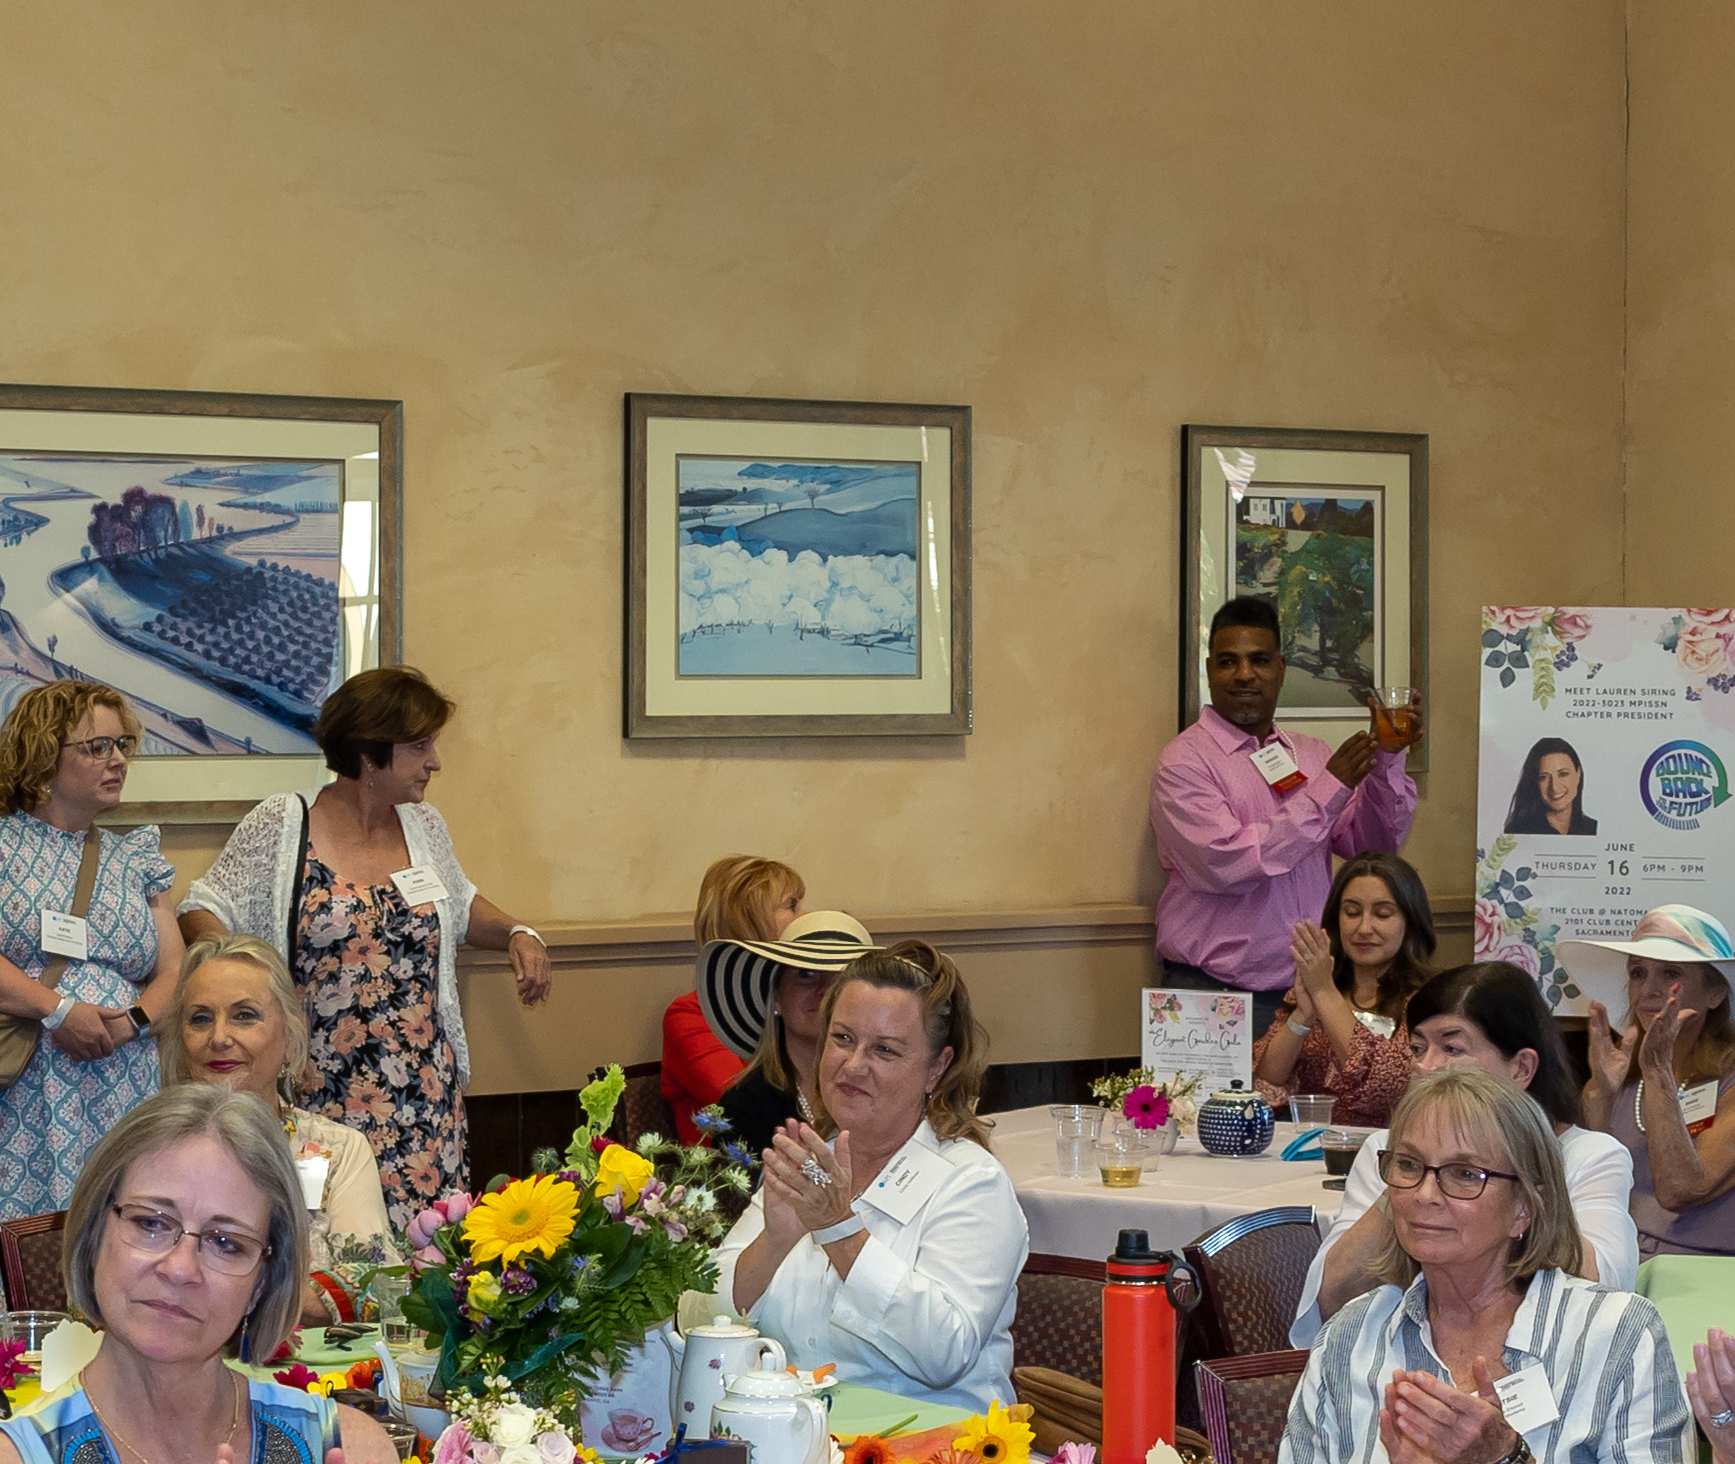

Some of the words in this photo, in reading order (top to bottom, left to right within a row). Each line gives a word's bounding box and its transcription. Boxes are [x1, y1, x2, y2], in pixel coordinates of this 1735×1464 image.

[1629, 700, 1668, 708] MPISSN
[1566, 711, 1612, 719] CHAPTER
[1616, 711, 1674, 719] PRESIDENT
[1661, 777, 1710, 798] BACK
[1605, 843, 1635, 852] JUNE
[1535, 861, 1597, 871] THURSDAY
[1607, 860, 1630, 876] 16
[1642, 864, 1666, 872] 6PM
[1680, 864, 1704, 874] 9PM
[1605, 886, 1631, 895] 2022
[1598, 908, 1606, 916] @
[1587, 918, 1610, 926] CLUB
[1153, 1027, 1186, 1047] Elegant
[1188, 1029, 1218, 1049] Garden
[1219, 1030, 1241, 1051] Gala
[895, 1169, 910, 1186] CINDY
